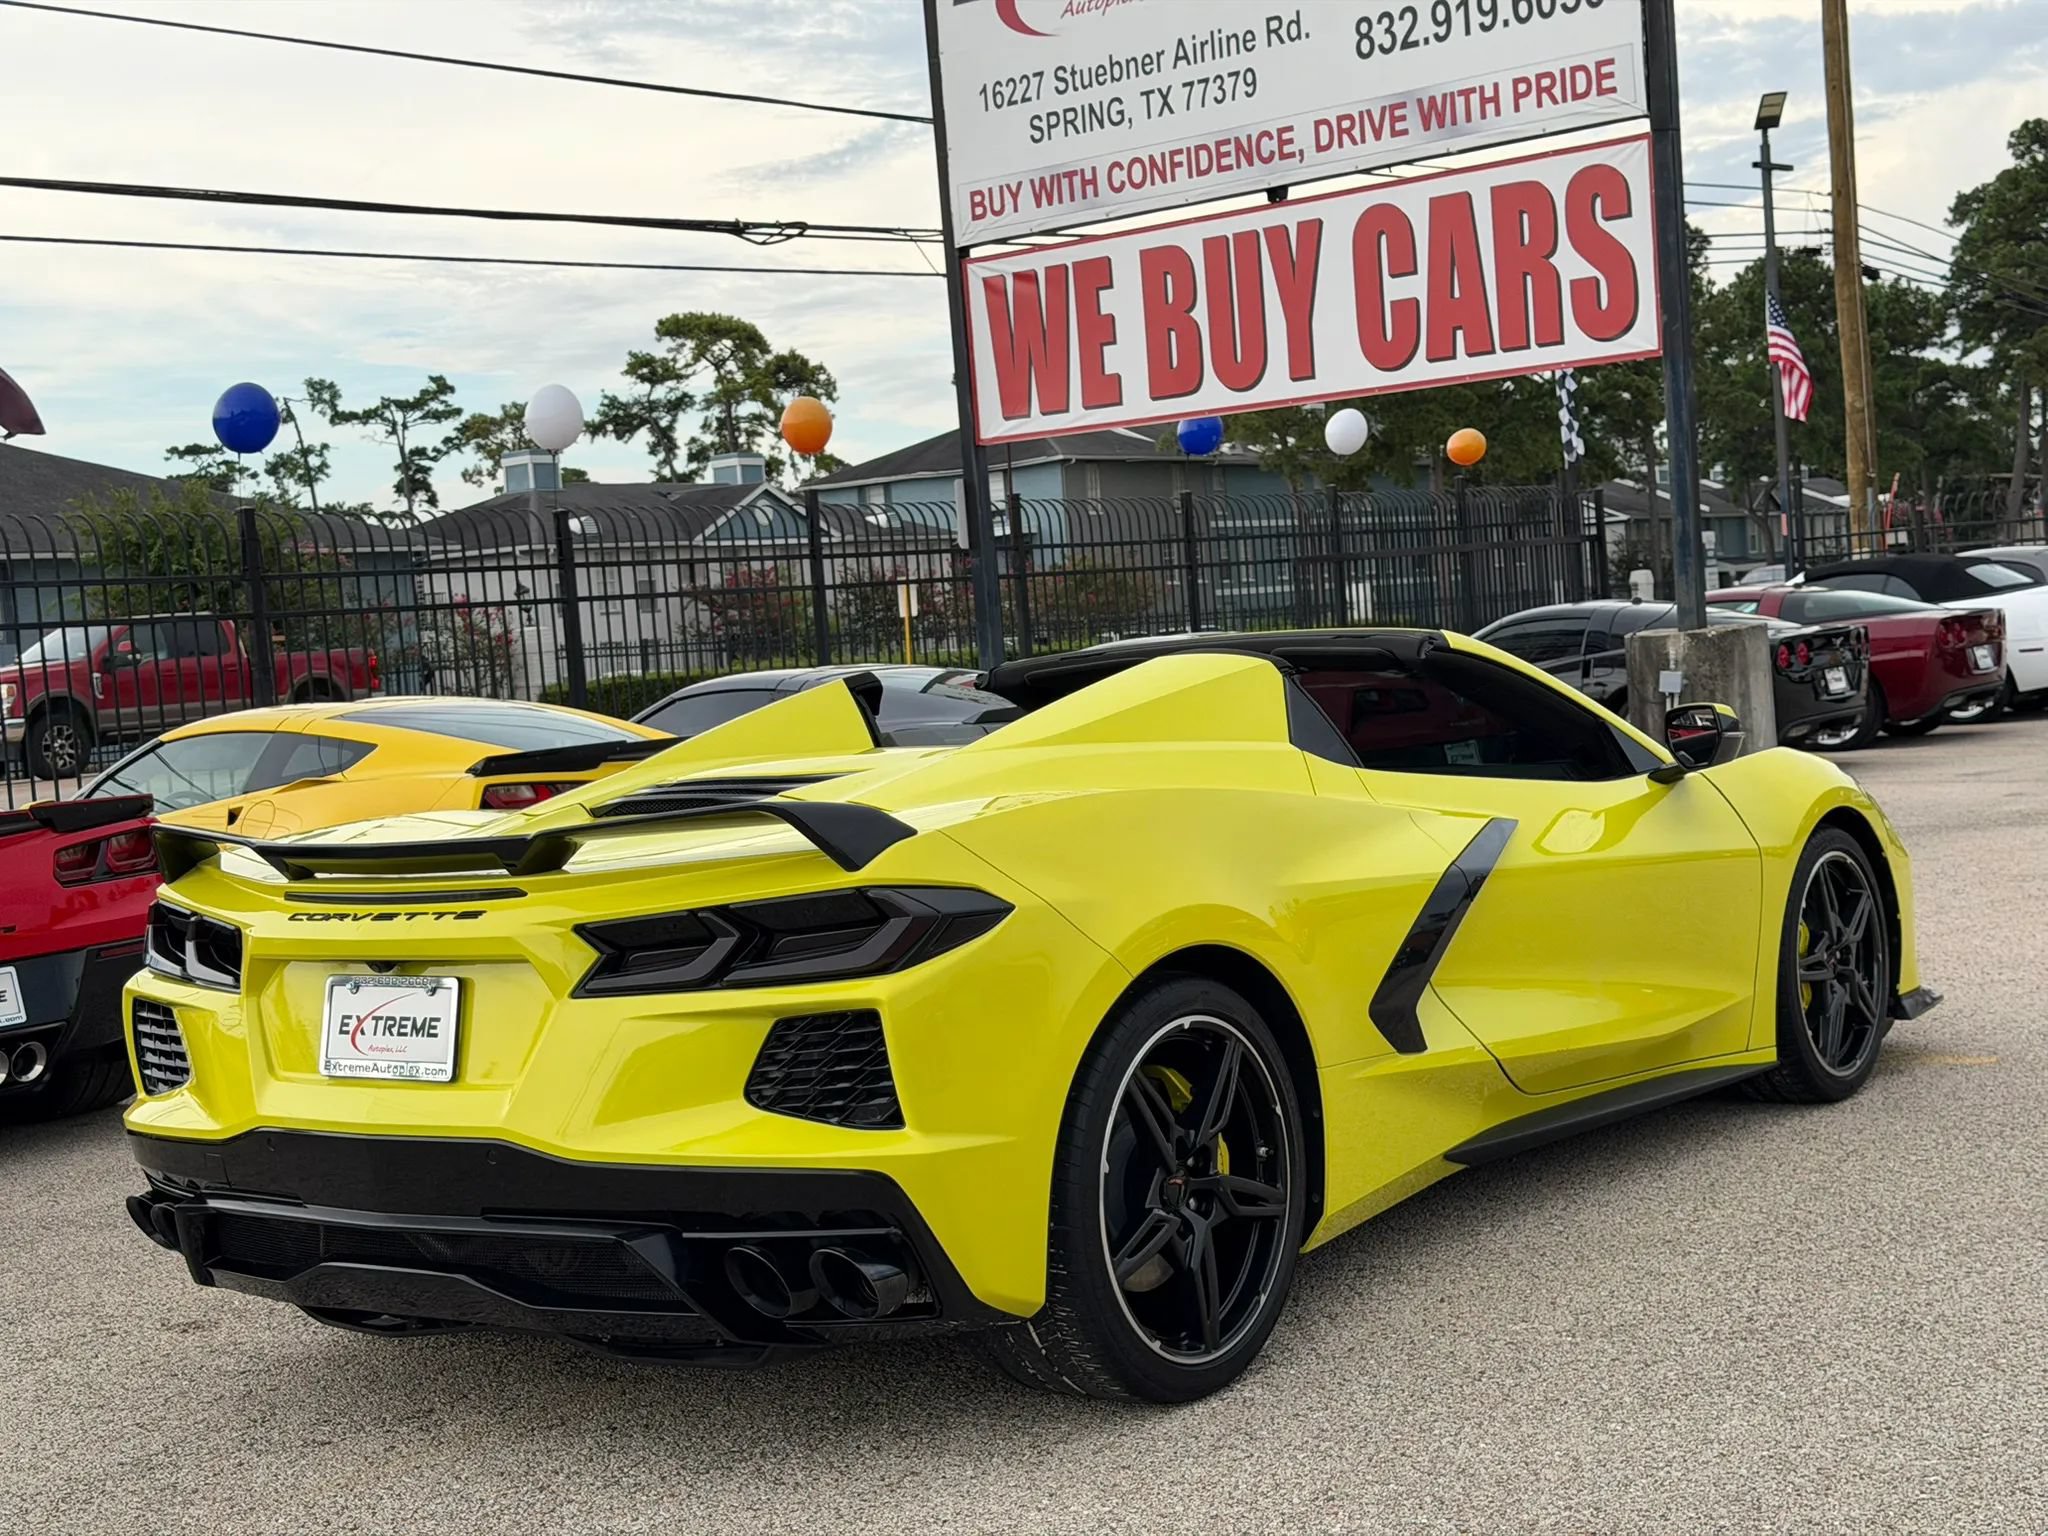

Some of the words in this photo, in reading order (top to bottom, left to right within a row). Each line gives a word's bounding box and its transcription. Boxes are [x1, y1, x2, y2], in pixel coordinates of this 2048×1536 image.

[1060, 0, 1143, 20] Autop
[1355, 0, 1601, 60] 832.919.6
[979, 71, 1045, 112] 16227
[1053, 49, 1165, 96] Stuebner
[1172, 28, 1256, 70] Airline
[1265, 10, 1311, 48] Rd.
[1029, 96, 1133, 144] SPRING,
[1140, 84, 1175, 120] TX
[1181, 67, 1258, 111] 77379
[969, 180, 1023, 221] BUY
[1029, 166, 1099, 210] WITH
[1106, 125, 1304, 194] CONFIDENCE,
[1313, 101, 1410, 153] DRIVE
[1416, 81, 1501, 132] WITH
[1512, 58, 1618, 113] PRIDE
[982, 255, 1123, 421] WE
[1139, 218, 1324, 401] BUY
[1351, 163, 1638, 373] CARS
[288, 910, 487, 922] CORVETTE
[338, 1014, 442, 1039] EXTREME
[324, 1060, 448, 1076] ExtremeAutoplex.com
